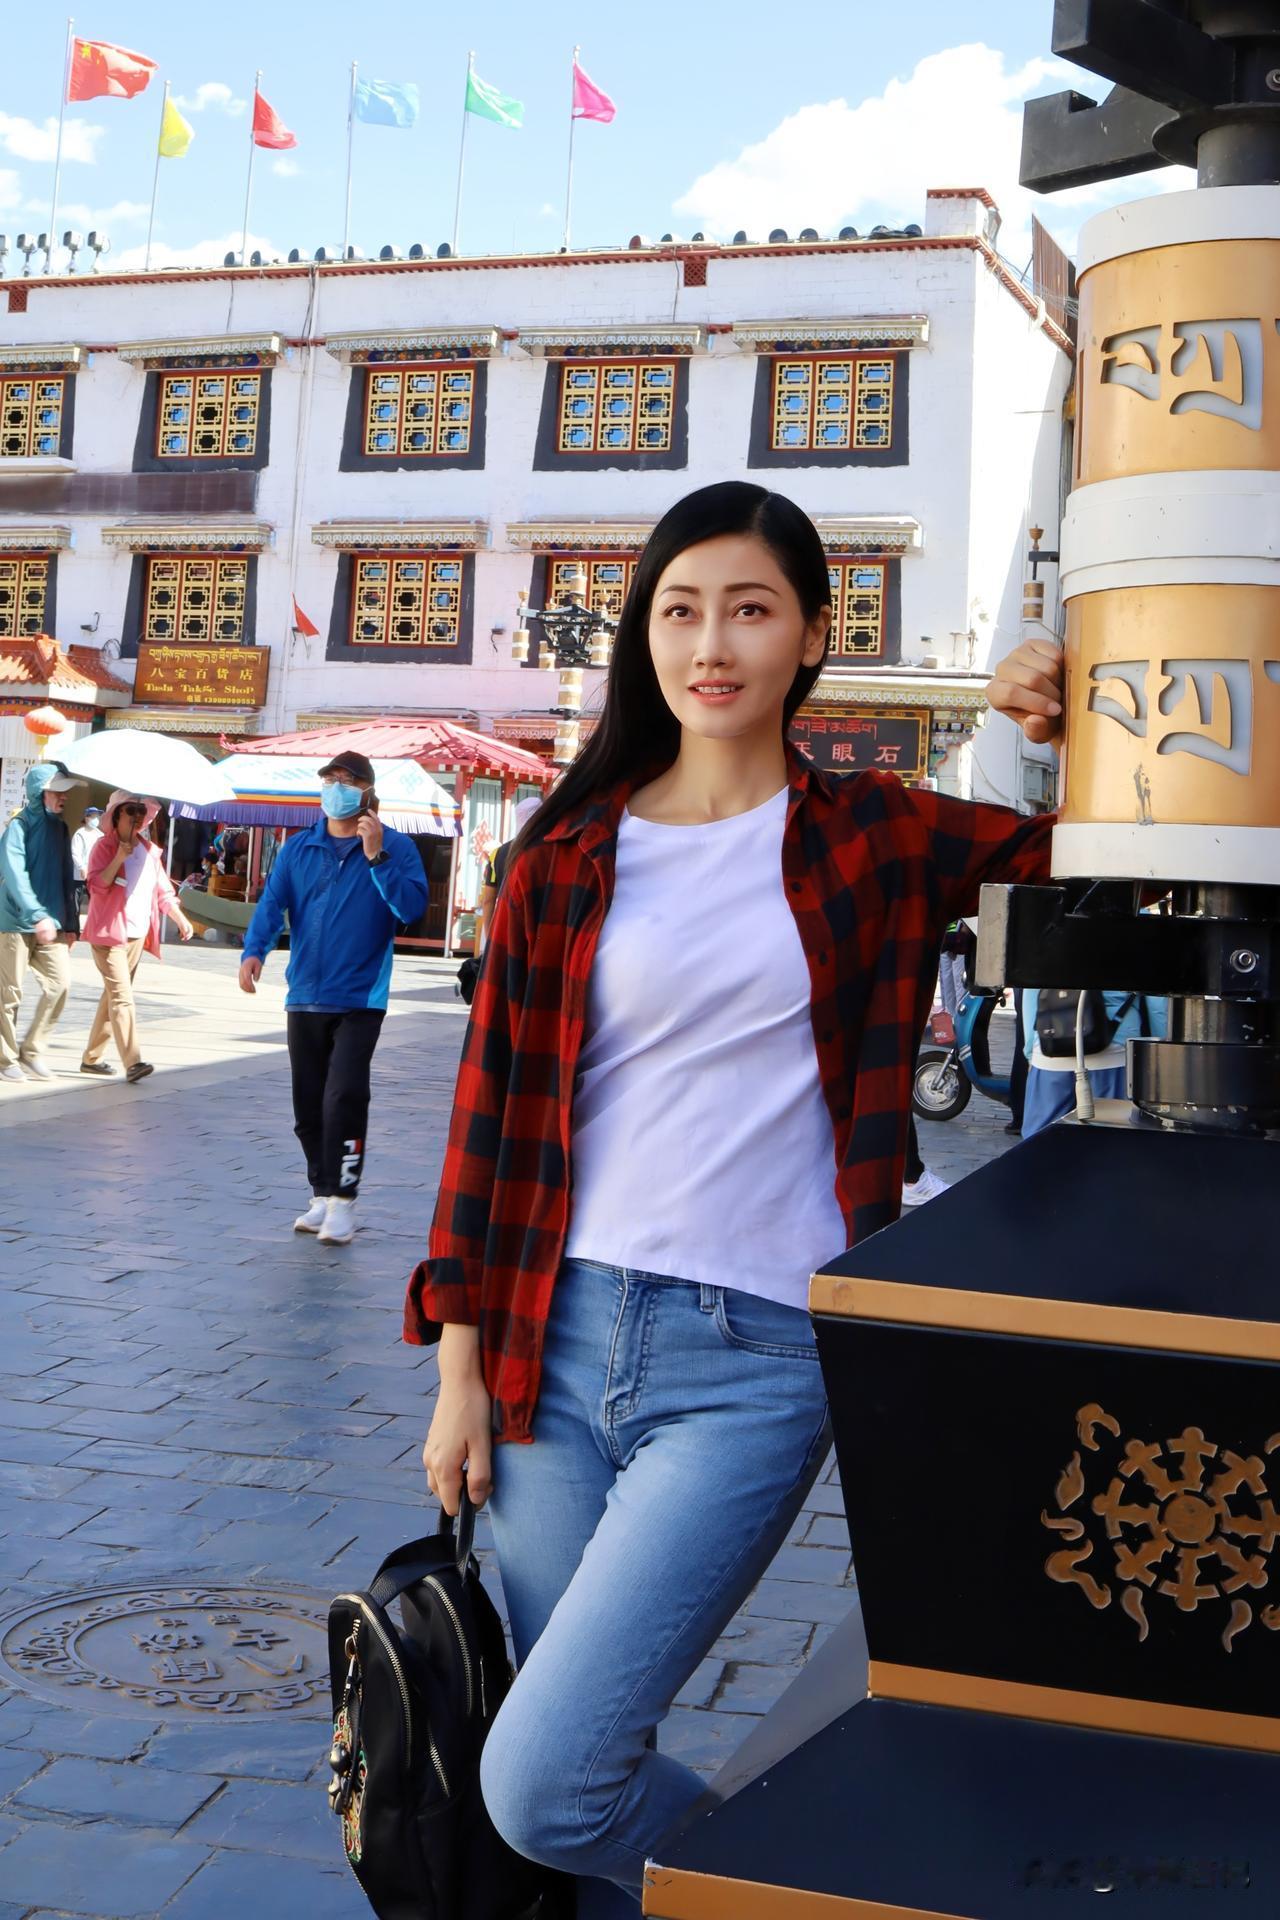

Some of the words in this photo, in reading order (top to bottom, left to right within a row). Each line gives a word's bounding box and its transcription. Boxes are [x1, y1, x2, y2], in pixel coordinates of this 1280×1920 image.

[150, 667, 254, 681] 八宝百货店
[339, 1138, 363, 1189] FILA
